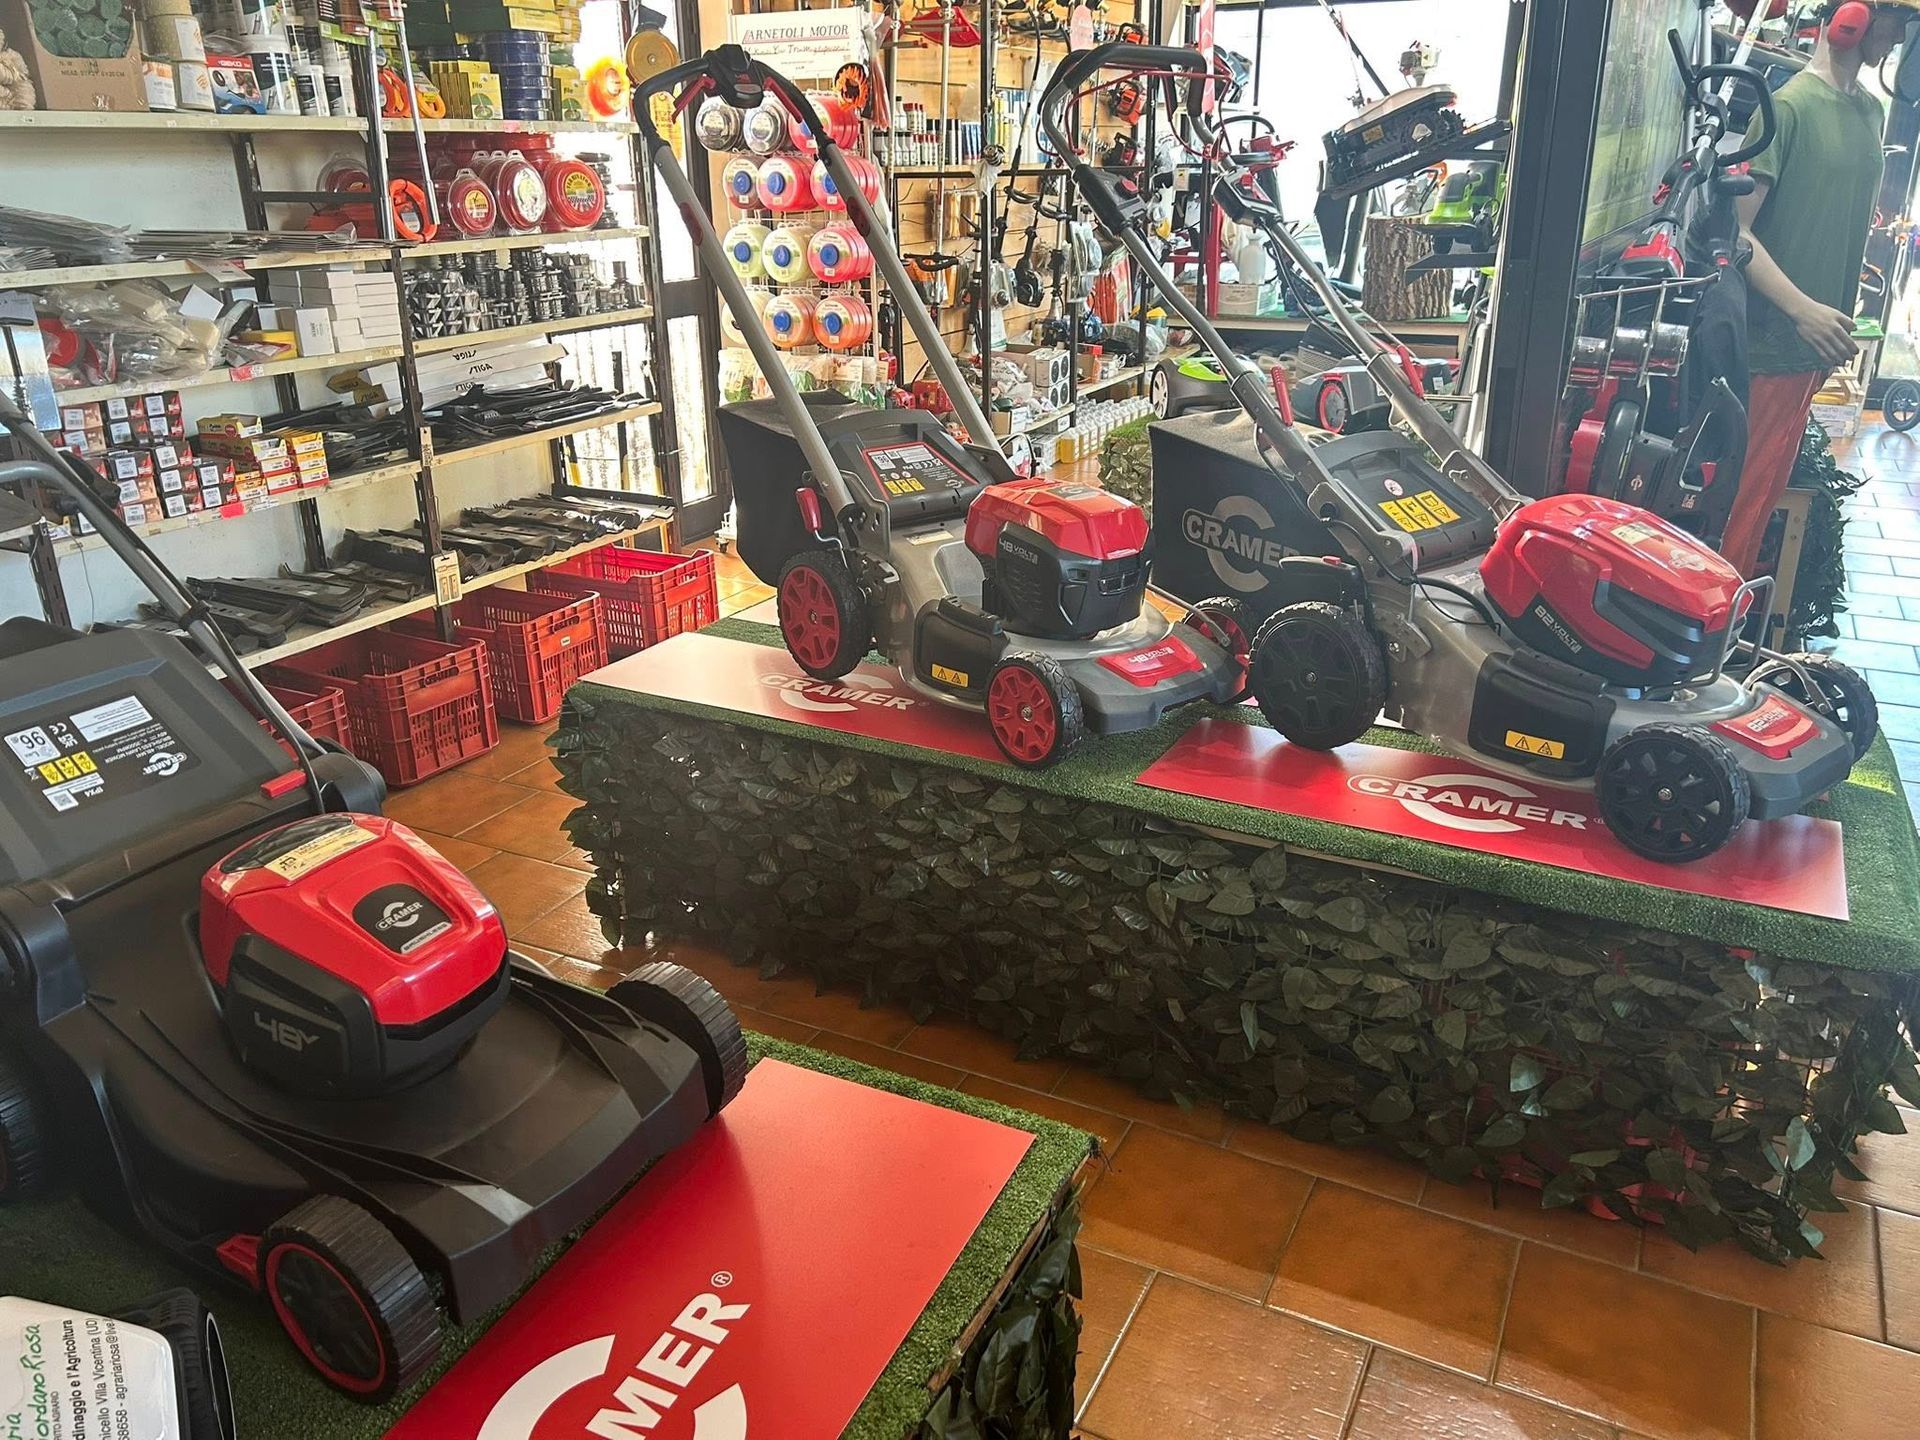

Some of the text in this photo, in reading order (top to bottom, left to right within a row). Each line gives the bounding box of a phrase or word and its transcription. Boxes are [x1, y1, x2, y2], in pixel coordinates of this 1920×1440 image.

[810, 24, 850, 37] MOTOR
[452, 350, 477, 361] STIGA
[469, 363, 493, 375] STIGA
[999, 537, 1014, 553] 48
[1534, 604, 1555, 626] 82
[759, 675, 915, 711] CRAMER
[19, 731, 46, 749] 96
[143, 752, 187, 774] CRAMER
[1356, 777, 1588, 830] CRAMER
[378, 901, 423, 929] CRAMER
[19, 1324, 46, 1370] Riosa
[61, 1319, 82, 1378] l'Agricoltura
[89, 1337, 105, 1381] Vicentina
[93, 1382, 108, 1406] Villa
